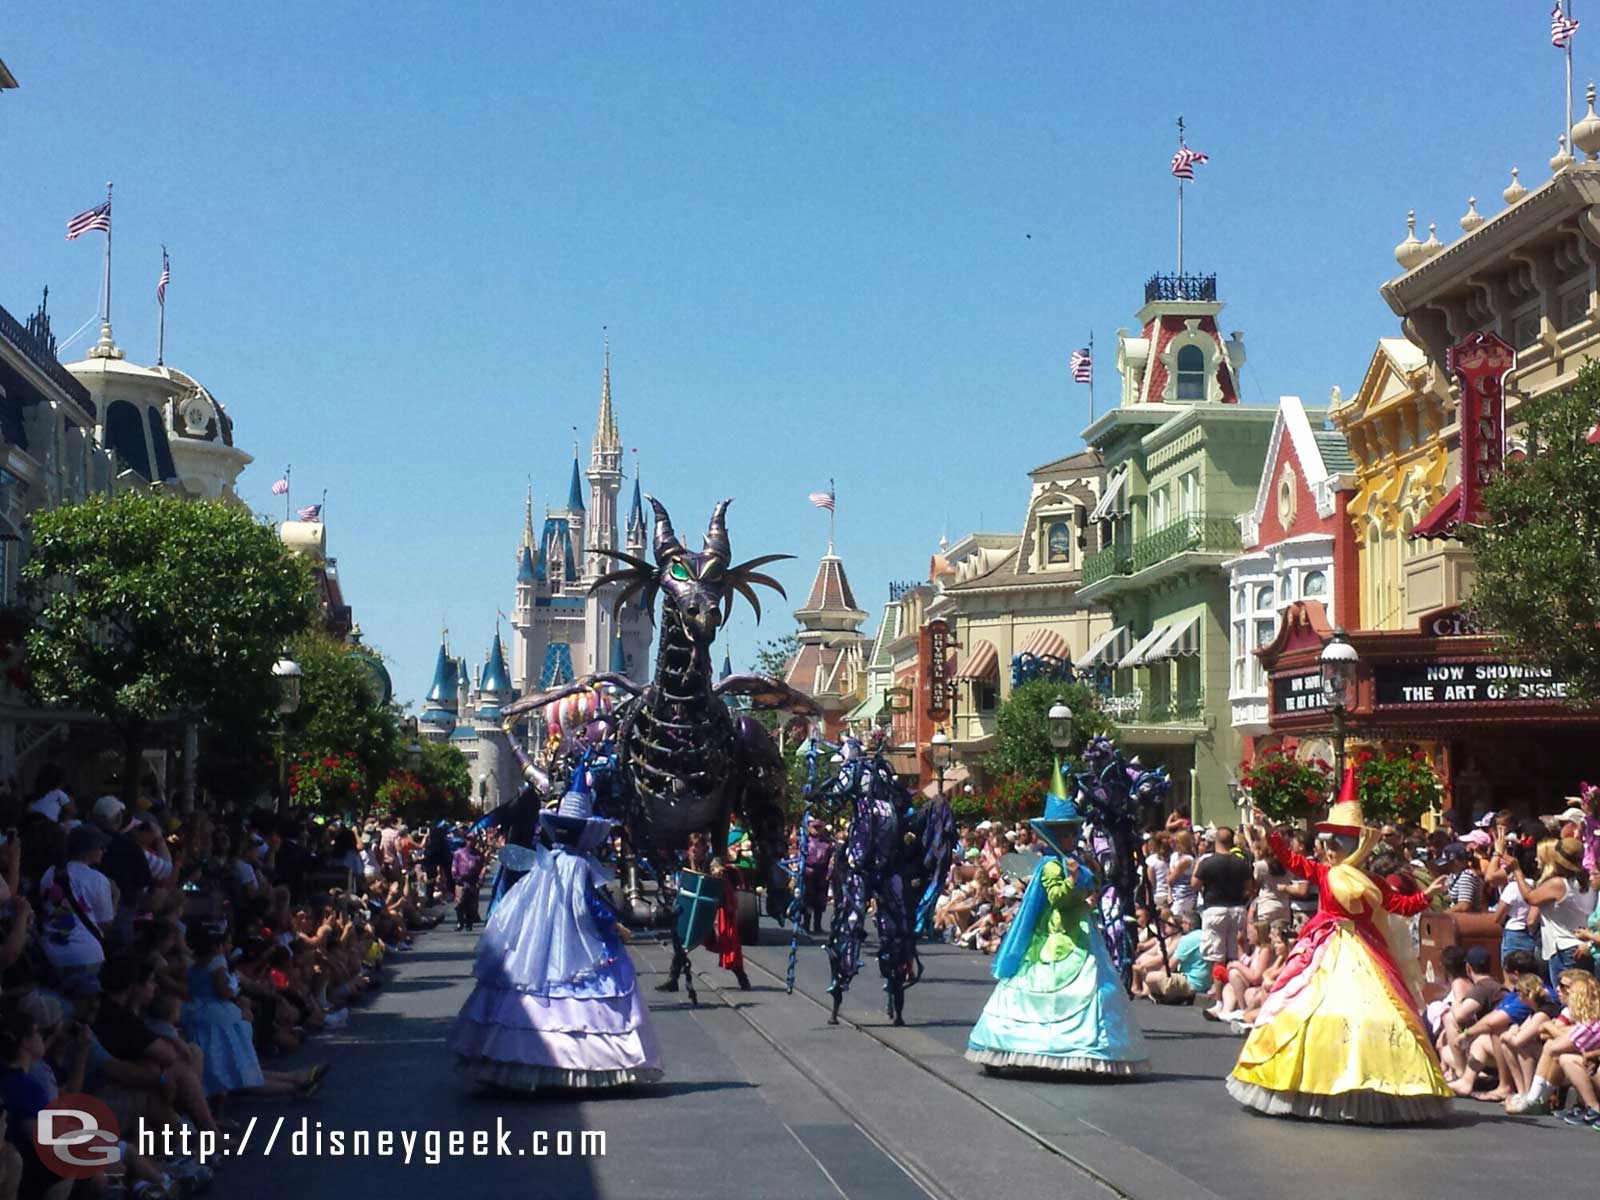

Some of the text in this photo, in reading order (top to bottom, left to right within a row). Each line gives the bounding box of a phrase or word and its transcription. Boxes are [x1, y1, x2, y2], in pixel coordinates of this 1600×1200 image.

[1427, 666, 1464, 681] NOW
[1402, 686, 1434, 701] THE
[1444, 685, 1476, 700] ART
[1519, 683, 1571, 697] DISNE
